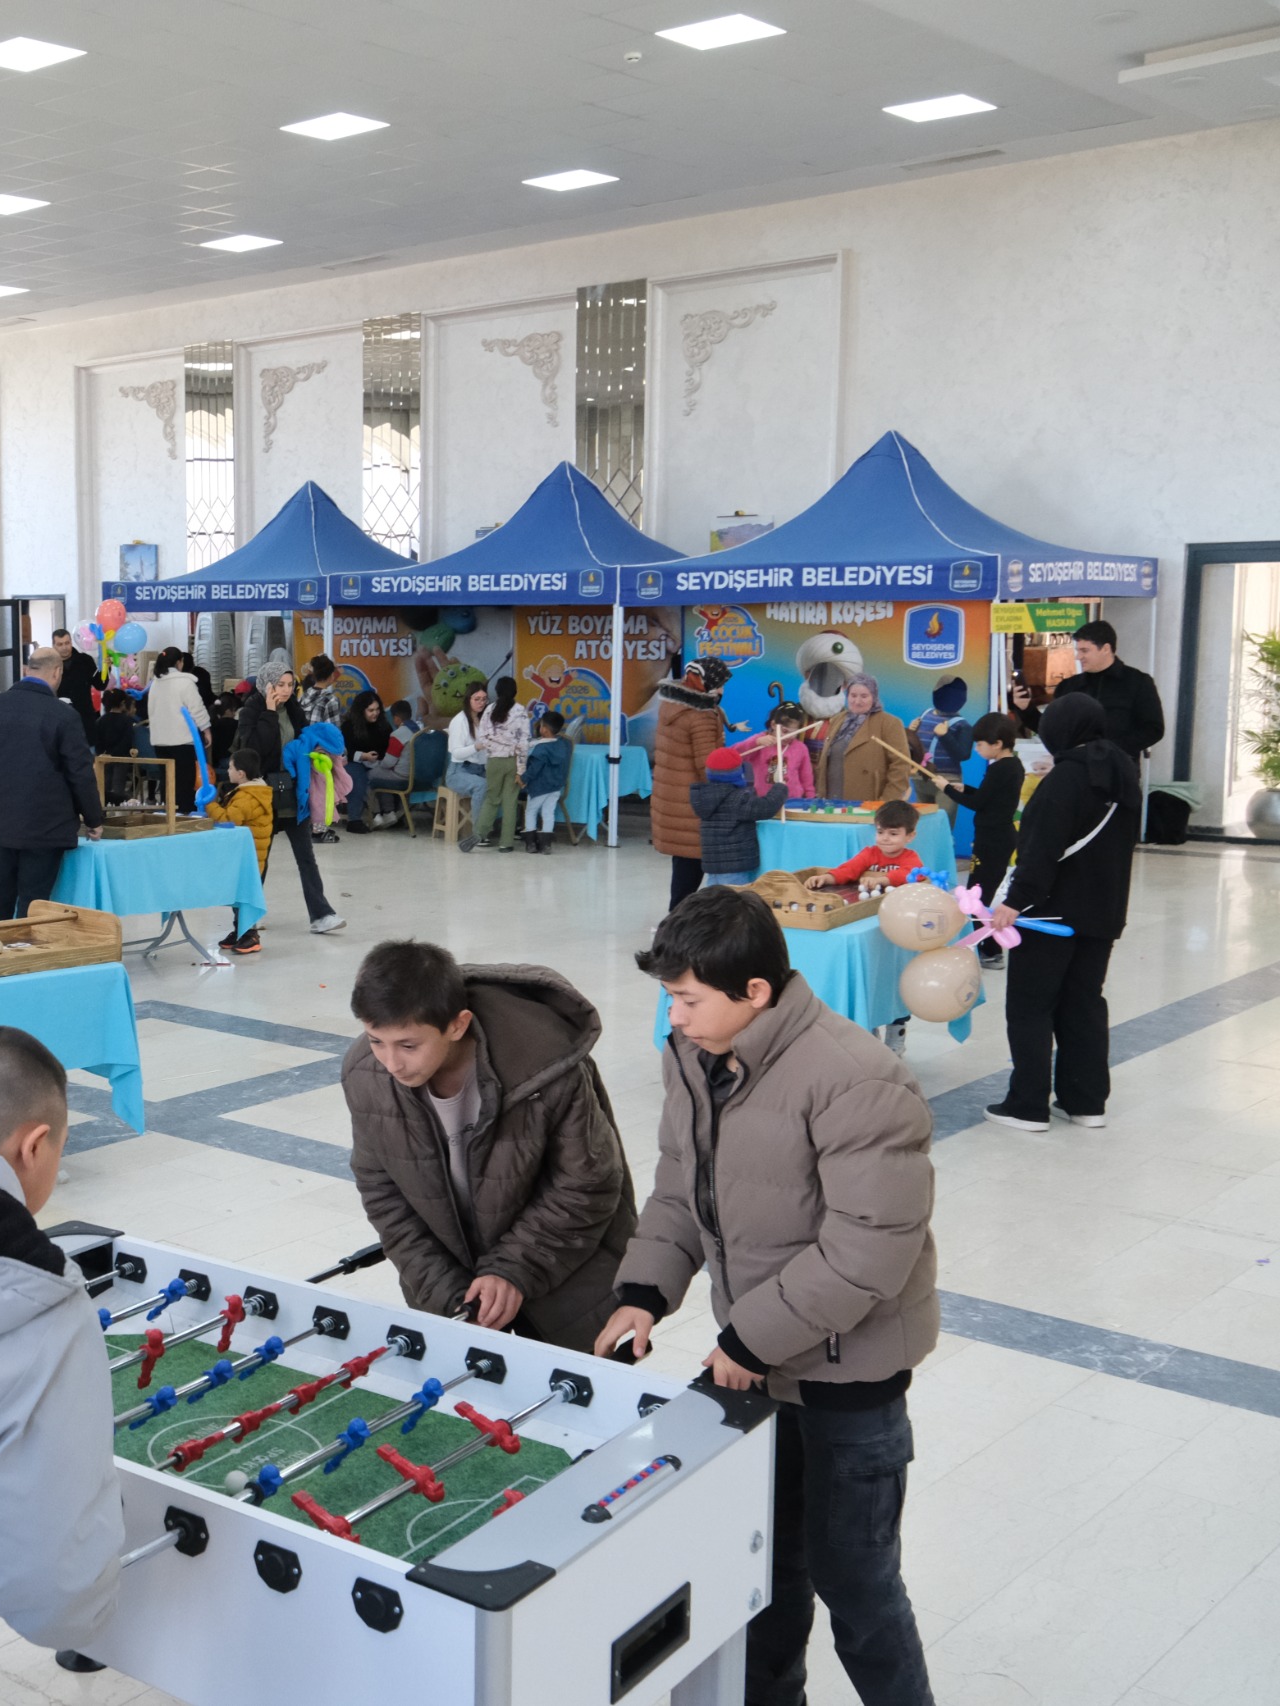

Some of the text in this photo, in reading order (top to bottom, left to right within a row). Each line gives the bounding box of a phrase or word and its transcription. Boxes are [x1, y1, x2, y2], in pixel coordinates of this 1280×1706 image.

[333, 616, 398, 635] BOYAMA
[527, 610, 564, 635] YÜZ
[340, 634, 413, 657] ATÖLYESİ
[574, 634, 667, 661] ATÖYESİ
